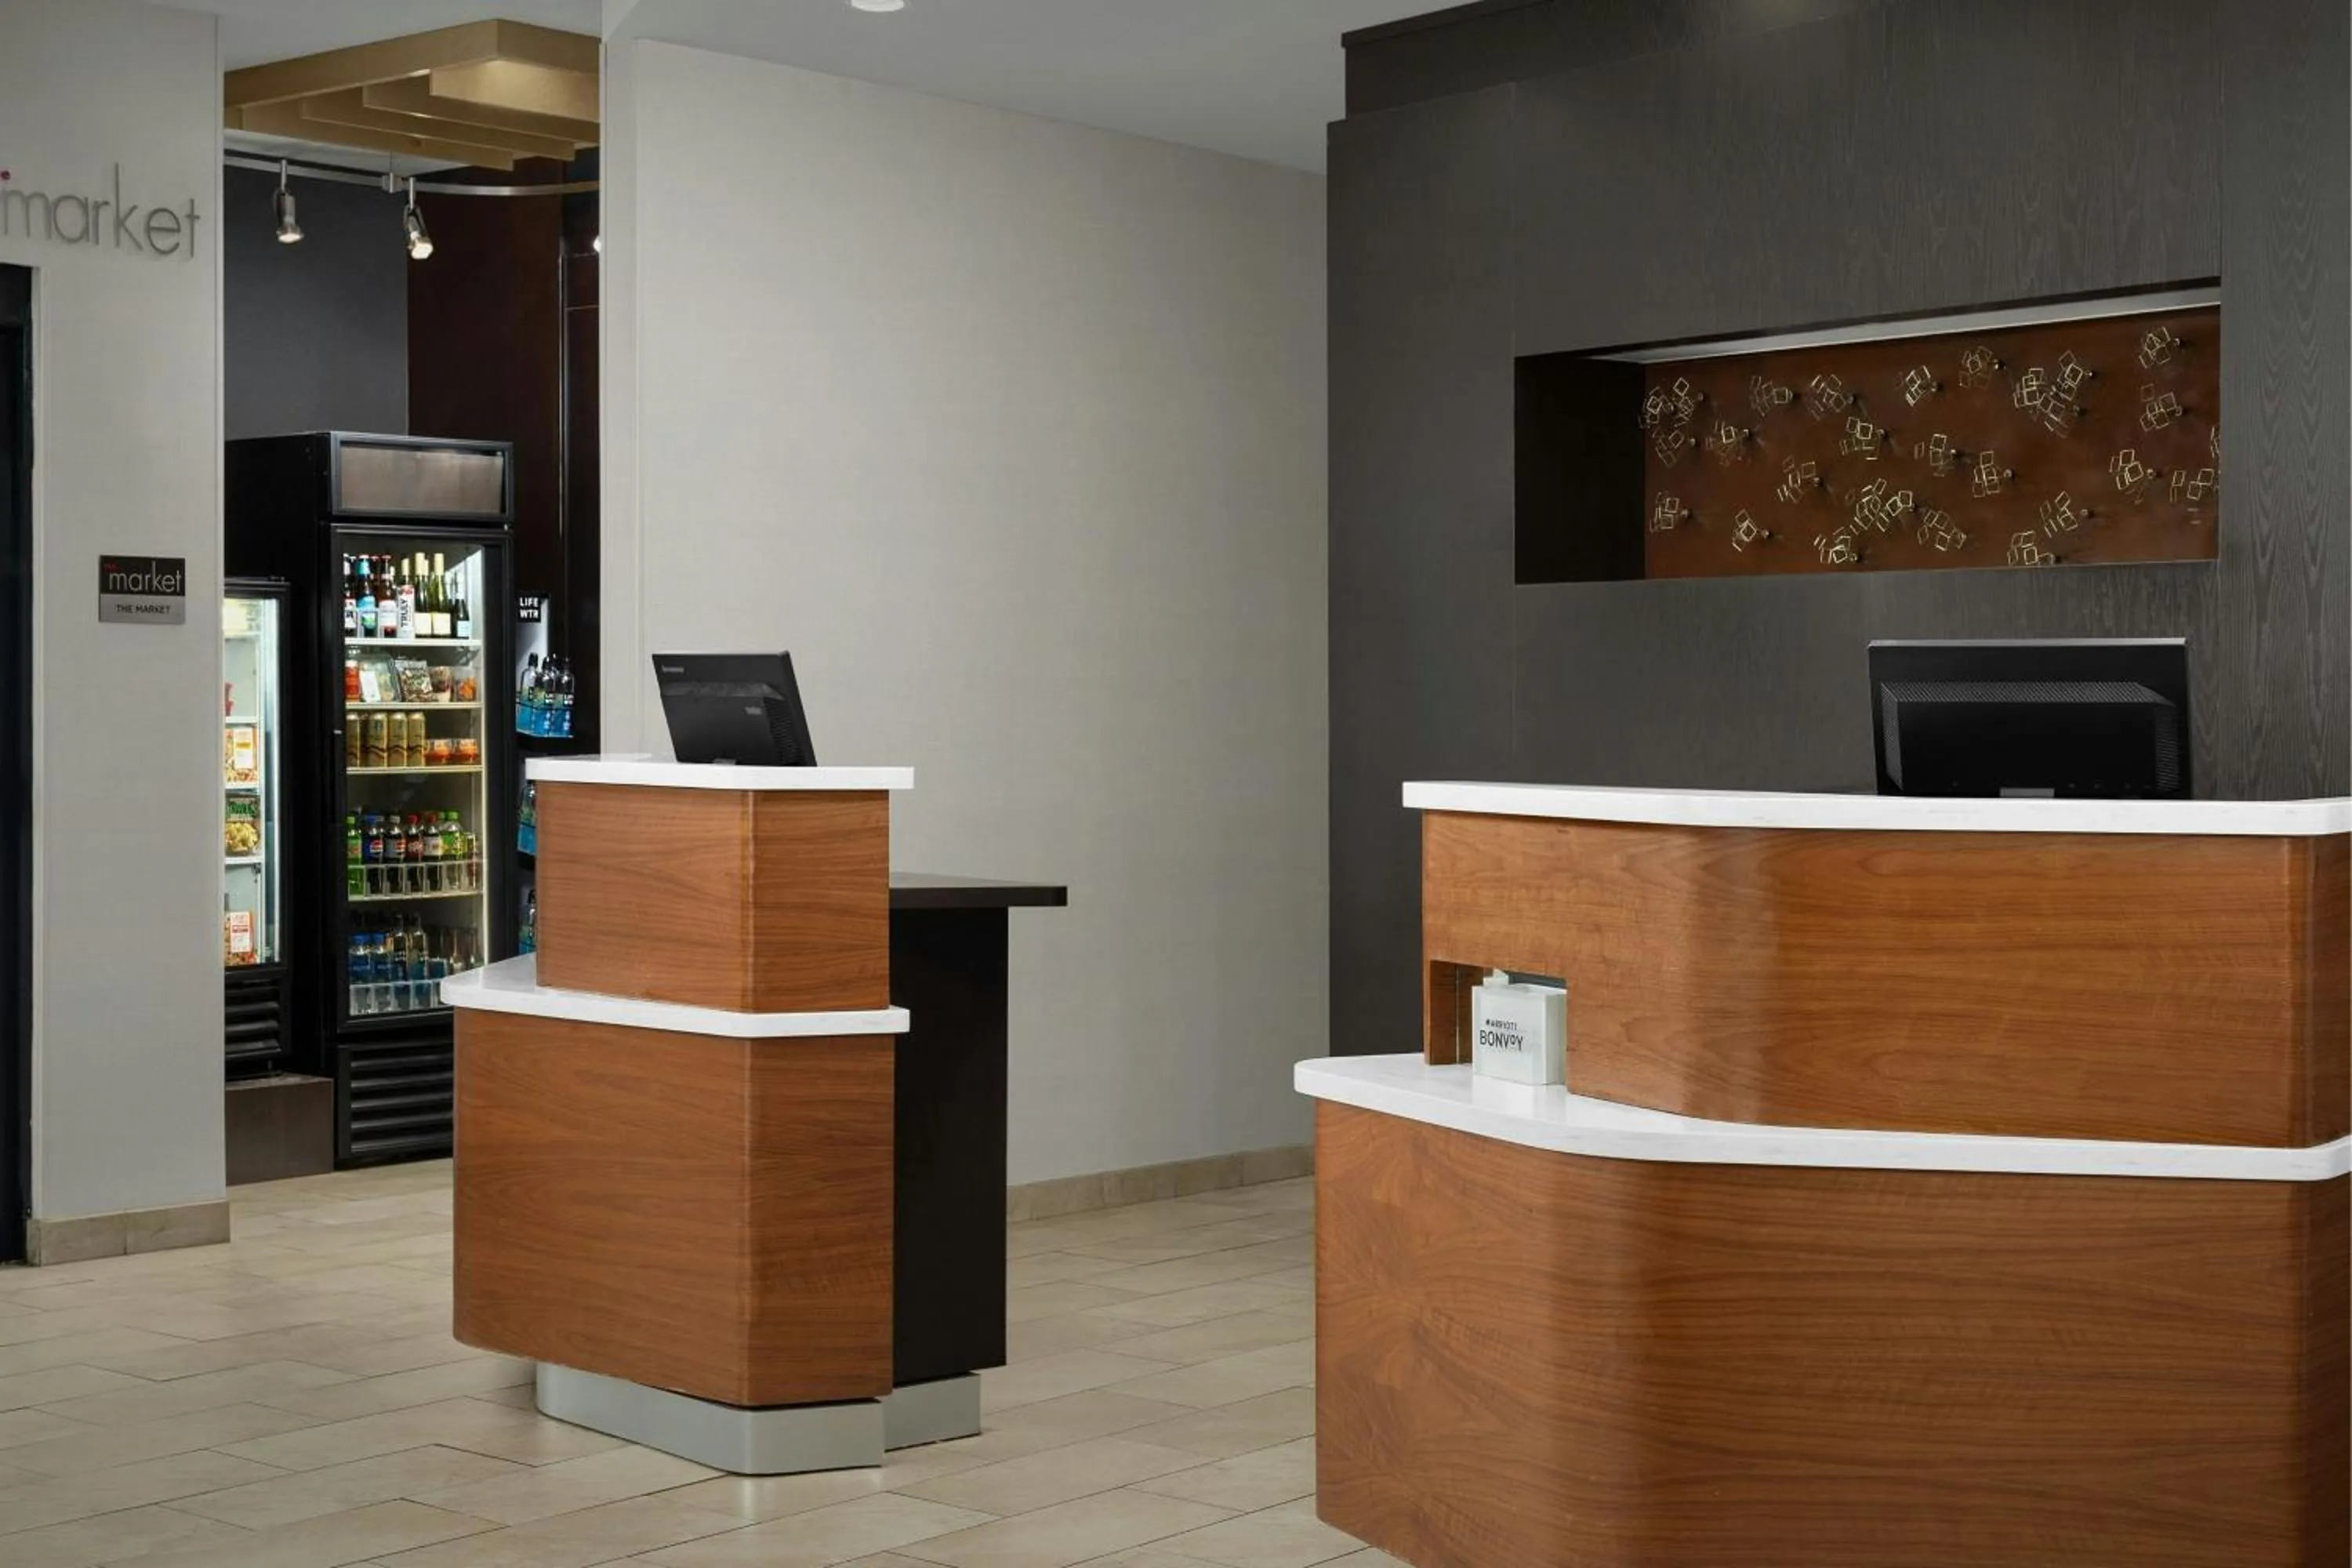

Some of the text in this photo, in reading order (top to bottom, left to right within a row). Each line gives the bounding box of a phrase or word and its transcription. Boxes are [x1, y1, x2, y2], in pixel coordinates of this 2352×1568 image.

[2, 162, 201, 259] market
[109, 560, 182, 593] market
[116, 604, 171, 615] THE MARKET
[520, 597, 539, 607] LIFE
[520, 609, 539, 619] WTR
[1479, 1029, 1523, 1051] BONVOY
